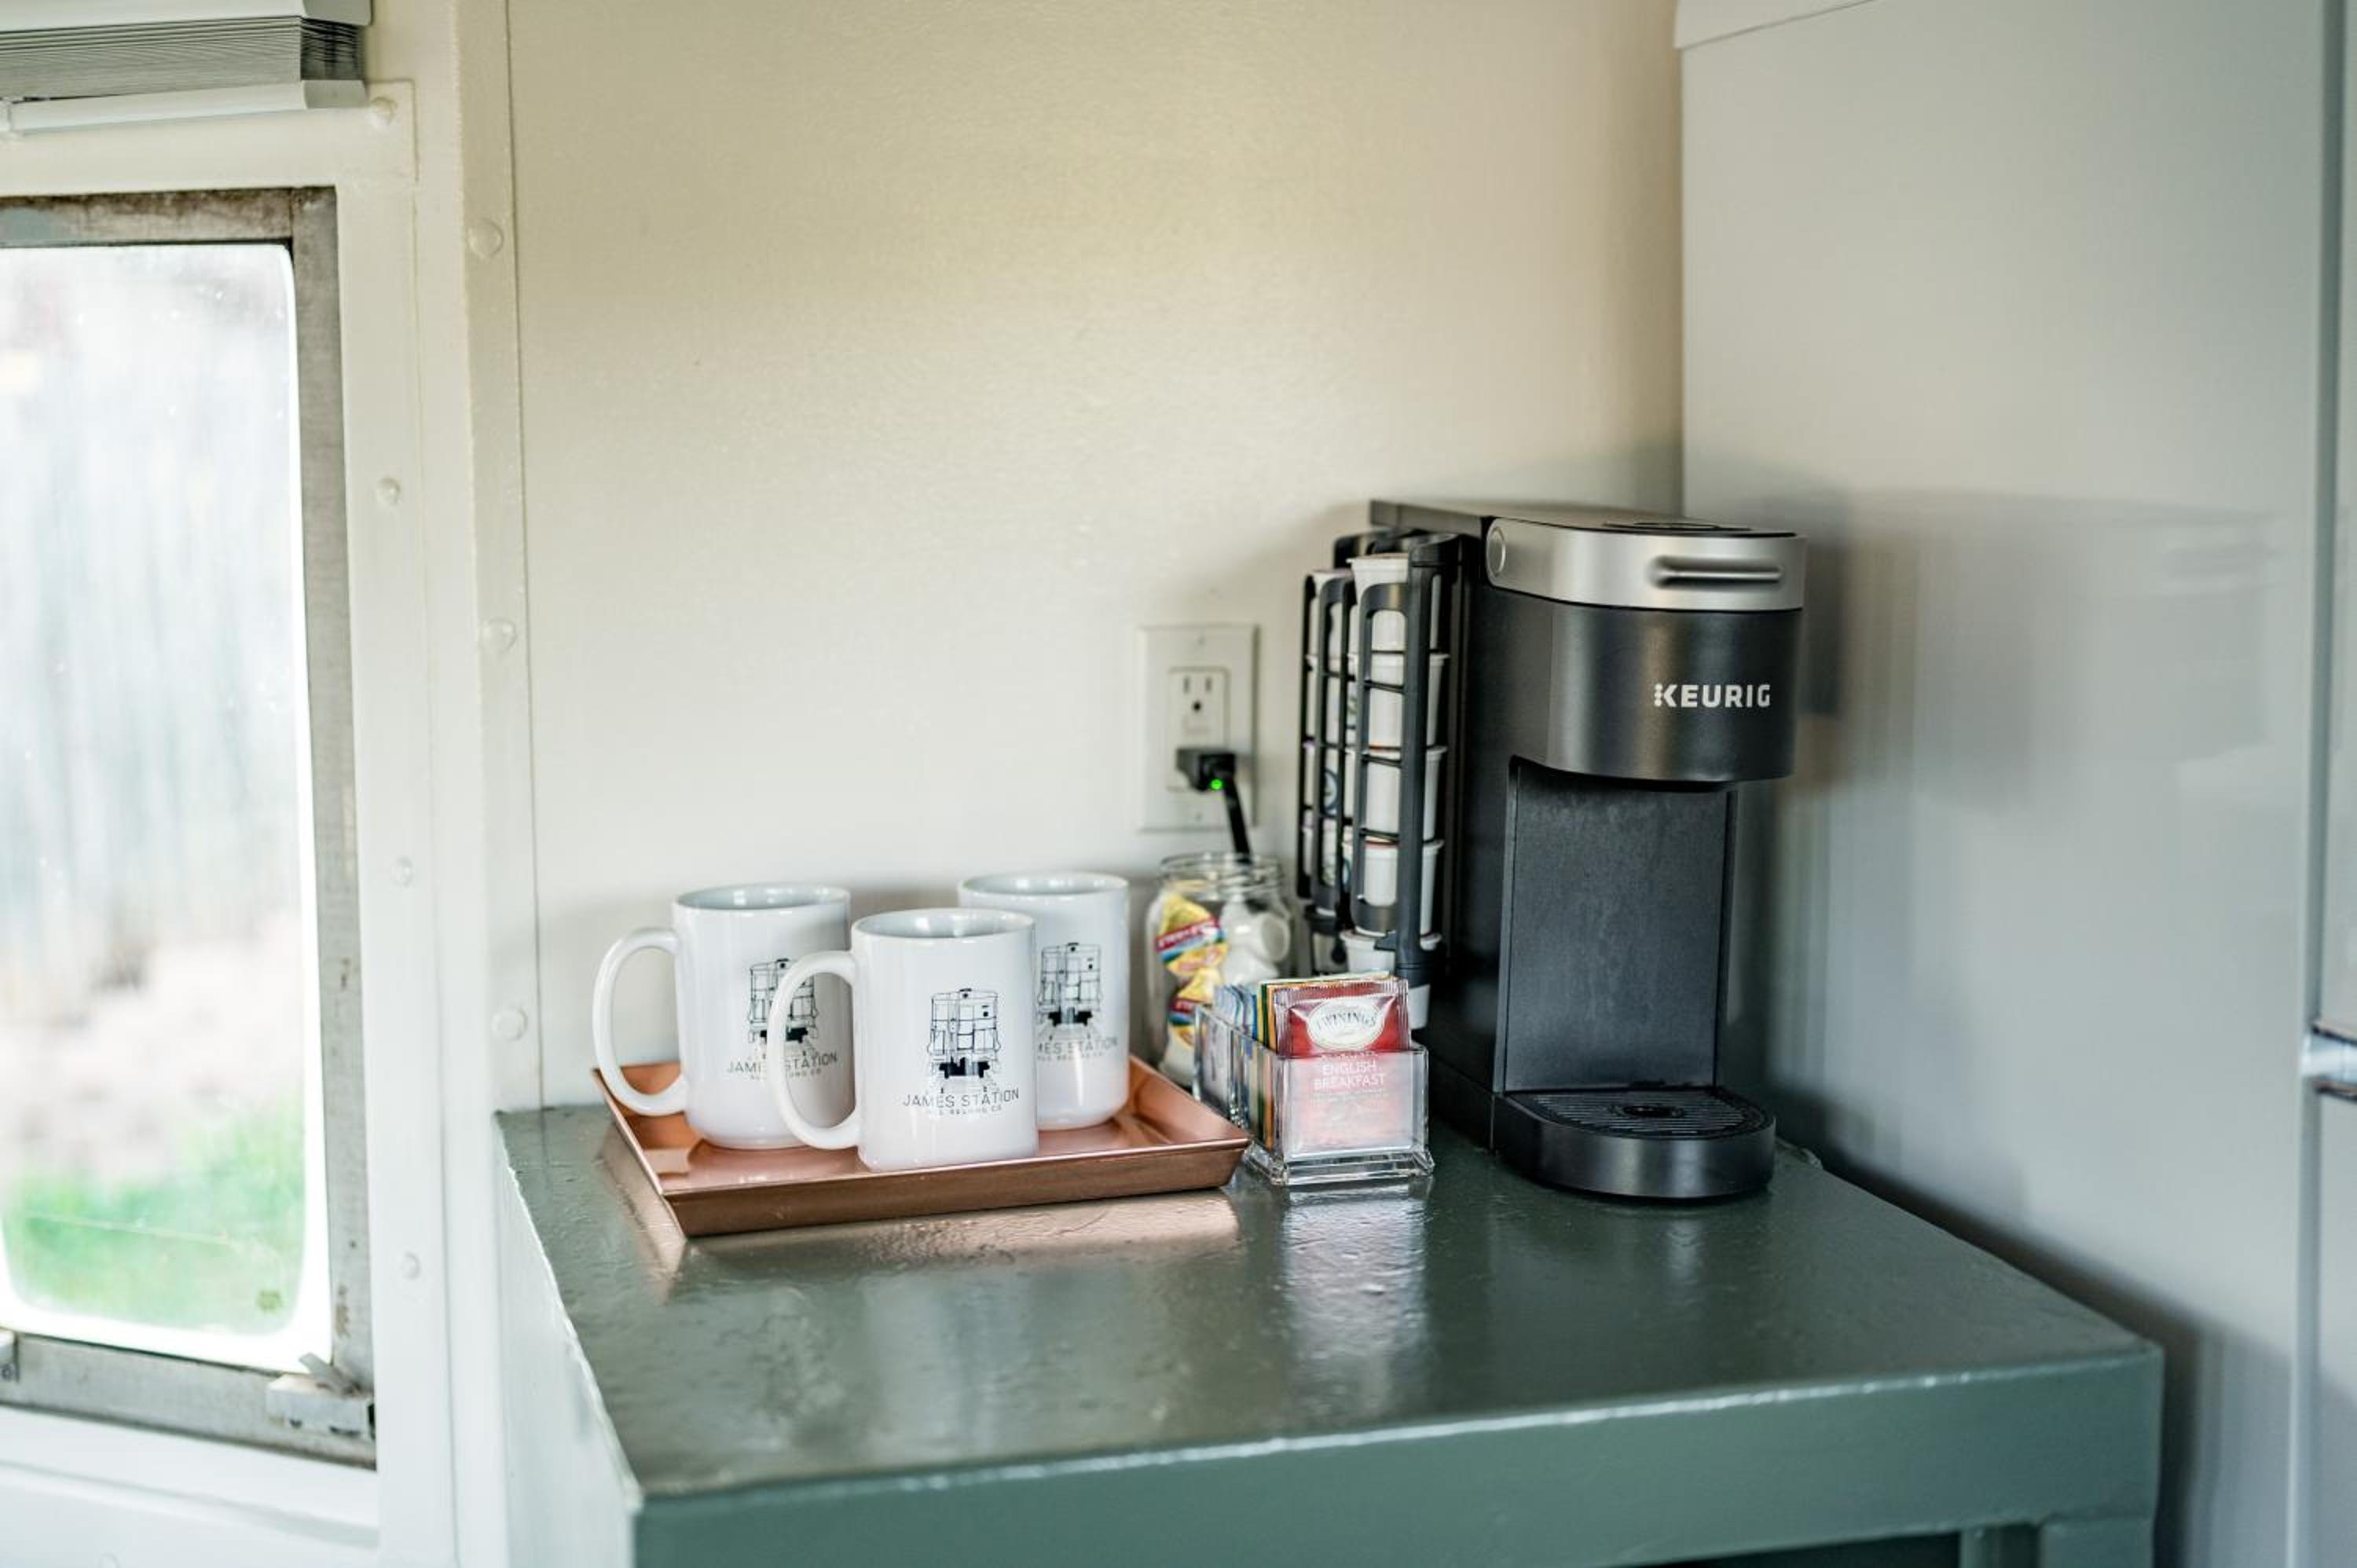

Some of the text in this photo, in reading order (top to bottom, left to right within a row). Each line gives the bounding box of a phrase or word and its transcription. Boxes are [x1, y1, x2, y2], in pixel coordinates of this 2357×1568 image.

[1654, 683, 1770, 707] KEURIG
[726, 1060, 768, 1074] JAME
[1321, 1058, 1376, 1075] ENGLISH
[1314, 1072, 1386, 1090] BREAKFAST
[903, 1087, 1020, 1108] JAMES STATION
